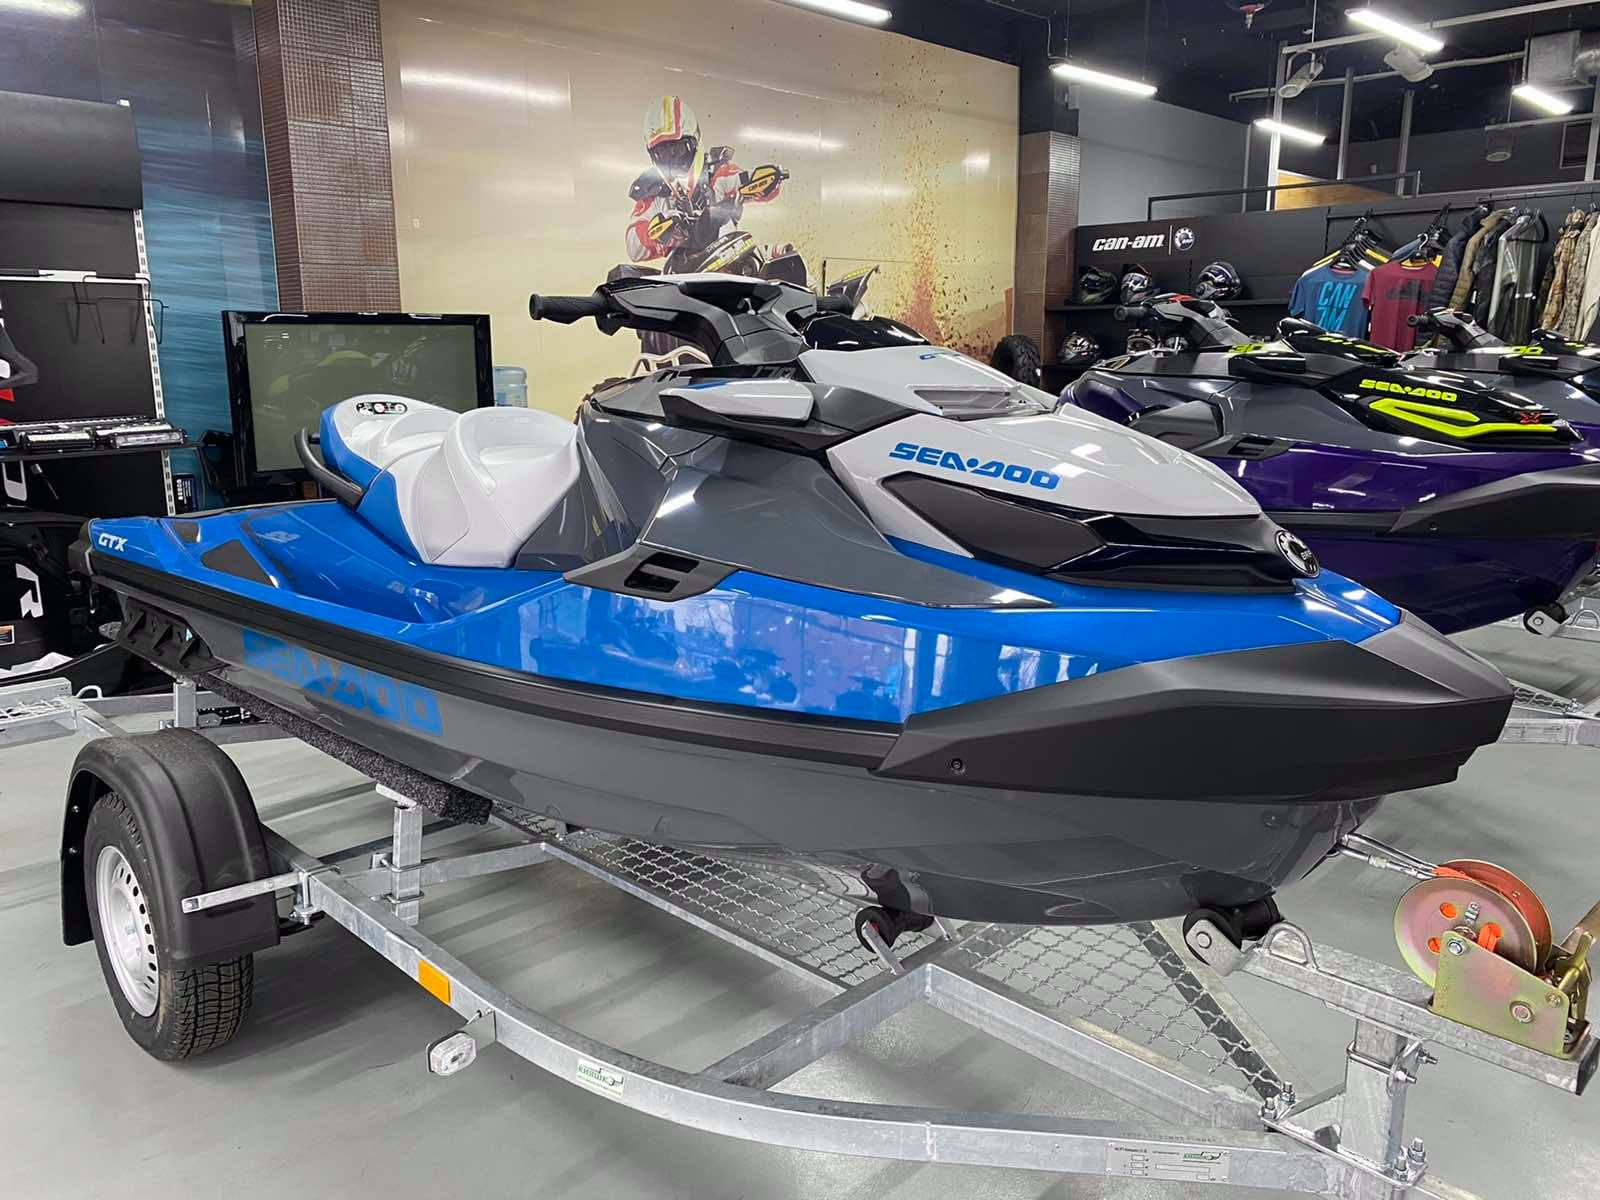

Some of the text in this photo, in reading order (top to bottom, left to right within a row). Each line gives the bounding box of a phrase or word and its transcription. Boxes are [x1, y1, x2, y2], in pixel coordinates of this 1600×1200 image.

[1092, 234, 1165, 252] can-am
[1317, 280, 1358, 307] CAN
[98, 532, 128, 552] GTX
